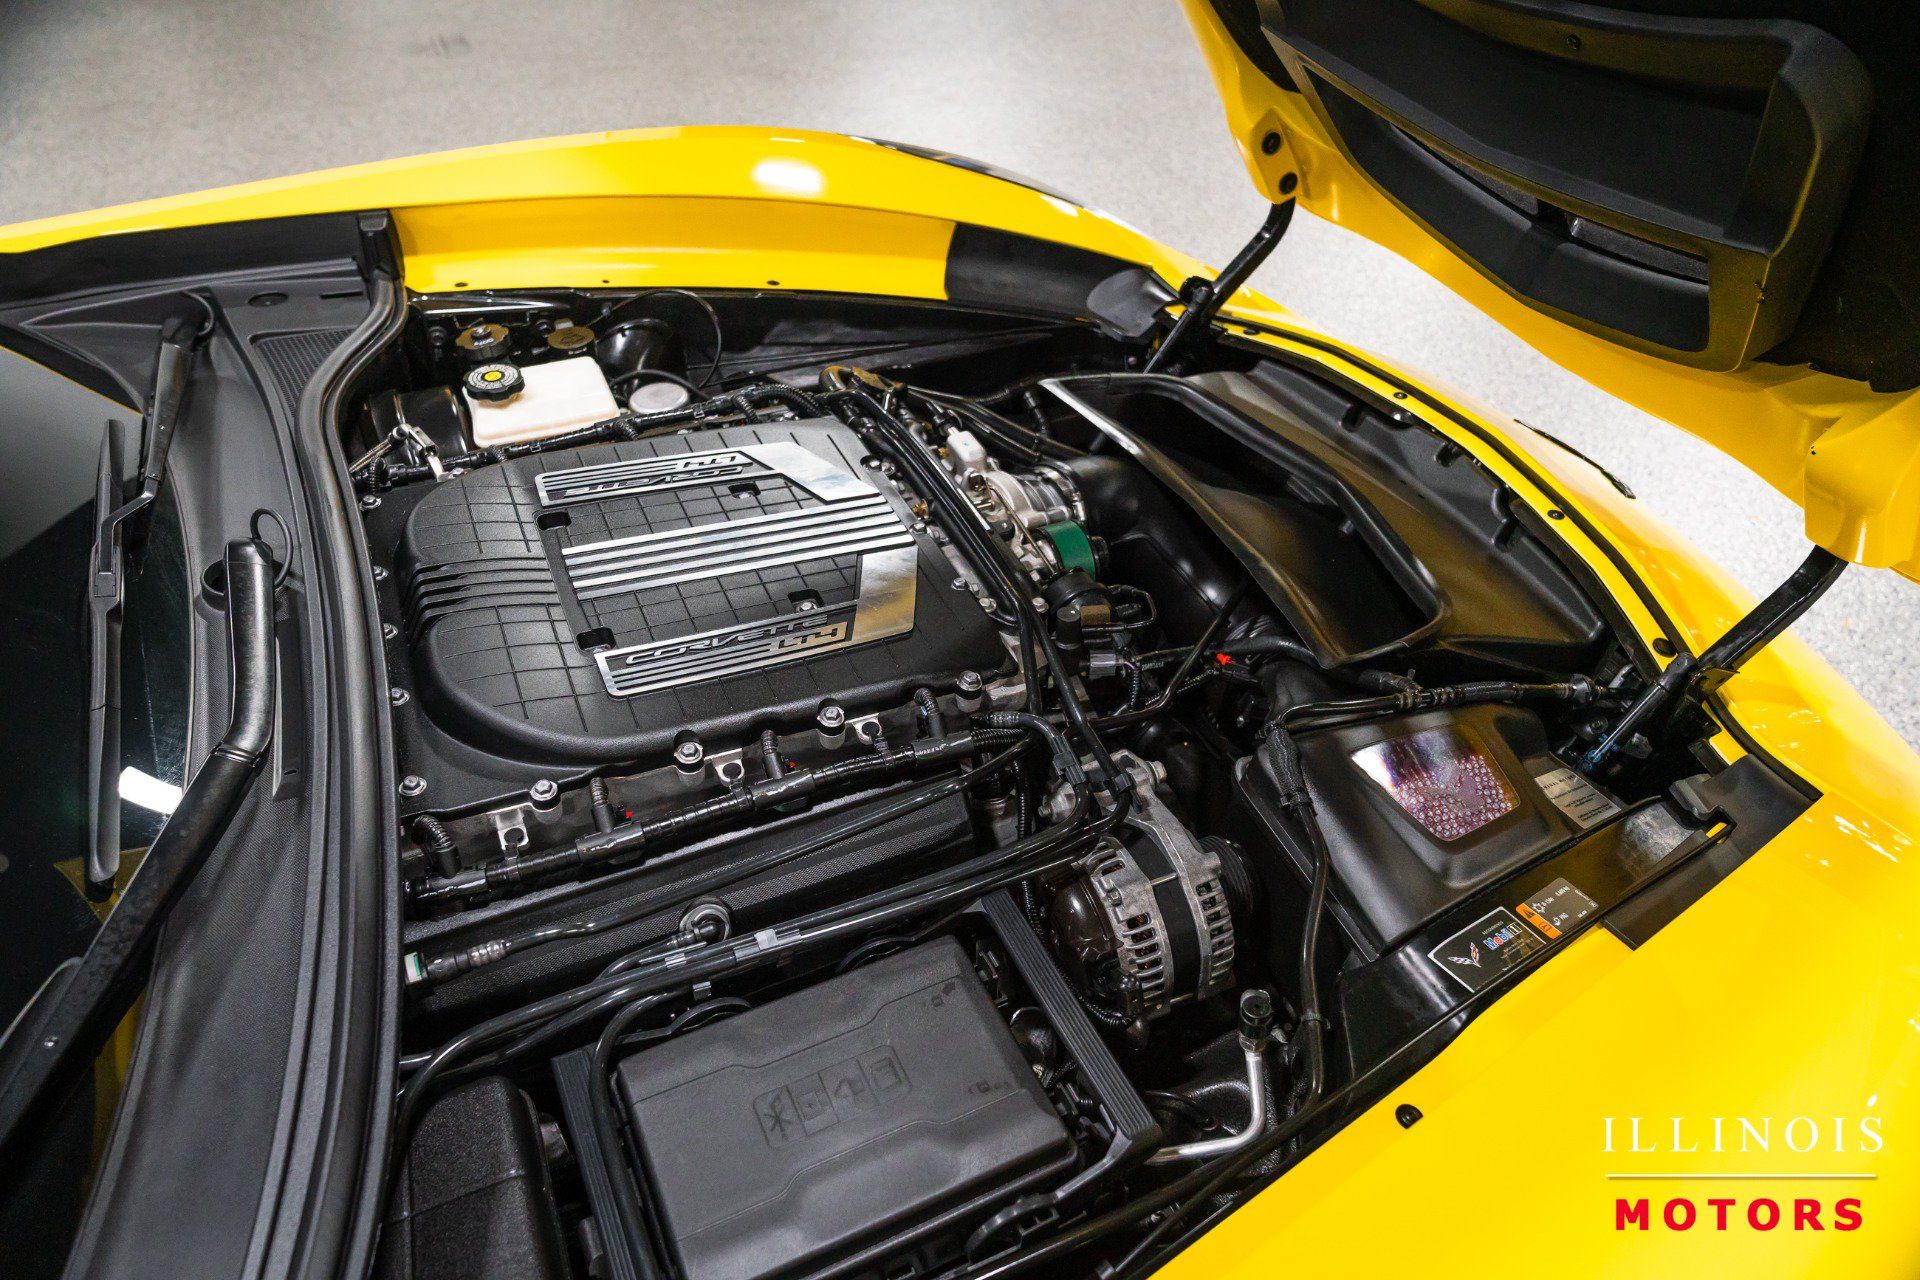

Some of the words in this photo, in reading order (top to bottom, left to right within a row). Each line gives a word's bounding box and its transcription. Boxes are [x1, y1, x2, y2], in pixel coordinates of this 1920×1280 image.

[564, 465, 744, 498] CORVETTE
[625, 614, 828, 666] CORVETTE
[774, 625, 842, 650] LT4
[1483, 927, 1514, 950] Mobil
